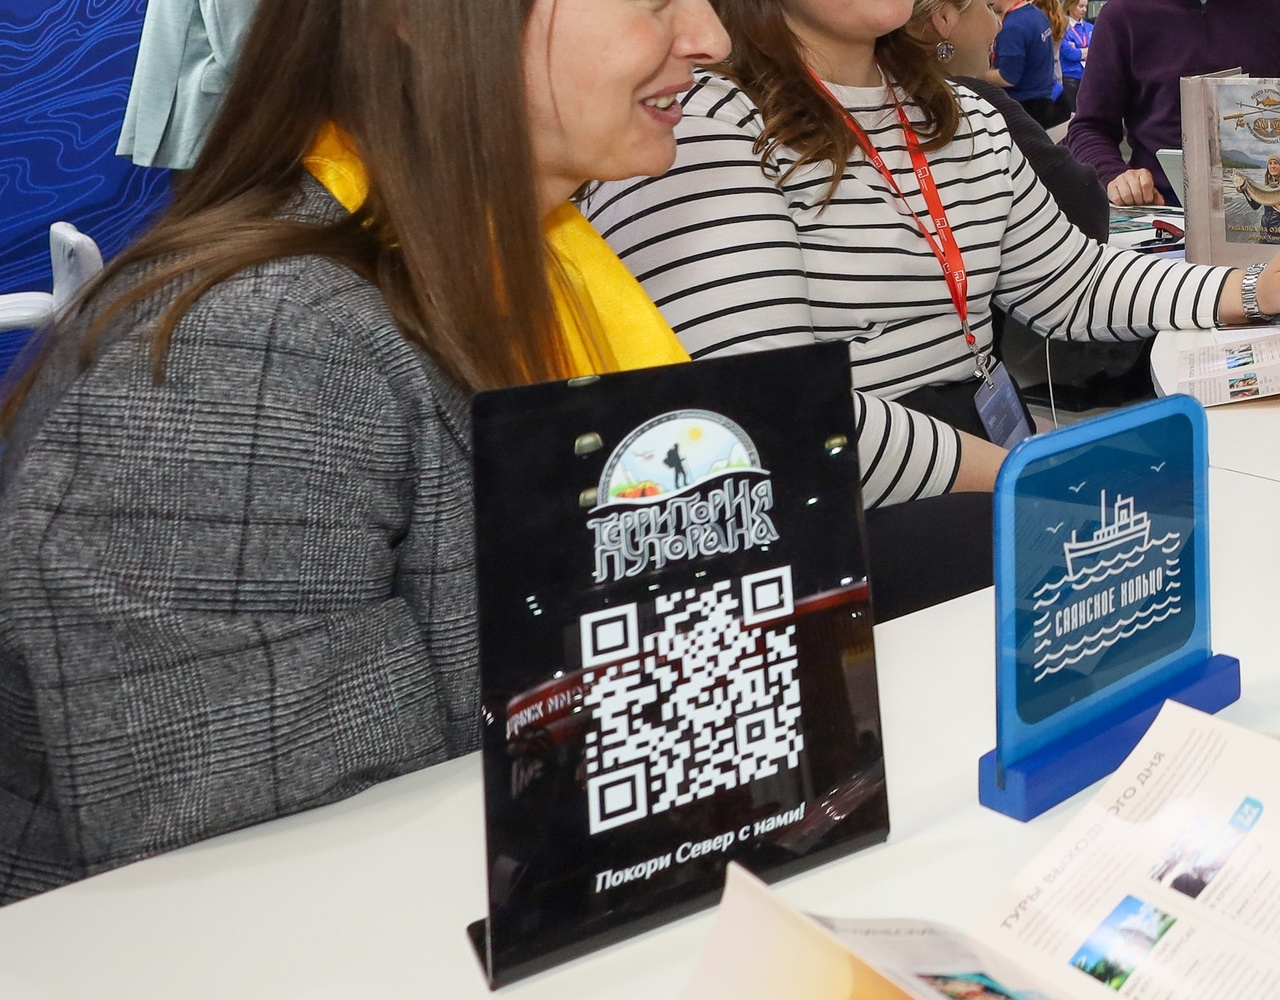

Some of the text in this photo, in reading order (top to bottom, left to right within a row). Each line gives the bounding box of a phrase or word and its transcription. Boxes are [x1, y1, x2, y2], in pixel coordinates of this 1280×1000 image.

[1055, 566, 1163, 638] САЯНСКОЕ КОЛЬЦО
[594, 801, 807, 893] Покори Север с нами!
[999, 885, 1044, 931] ТУРЫ
[1135, 750, 1166, 787] ДНЯ
